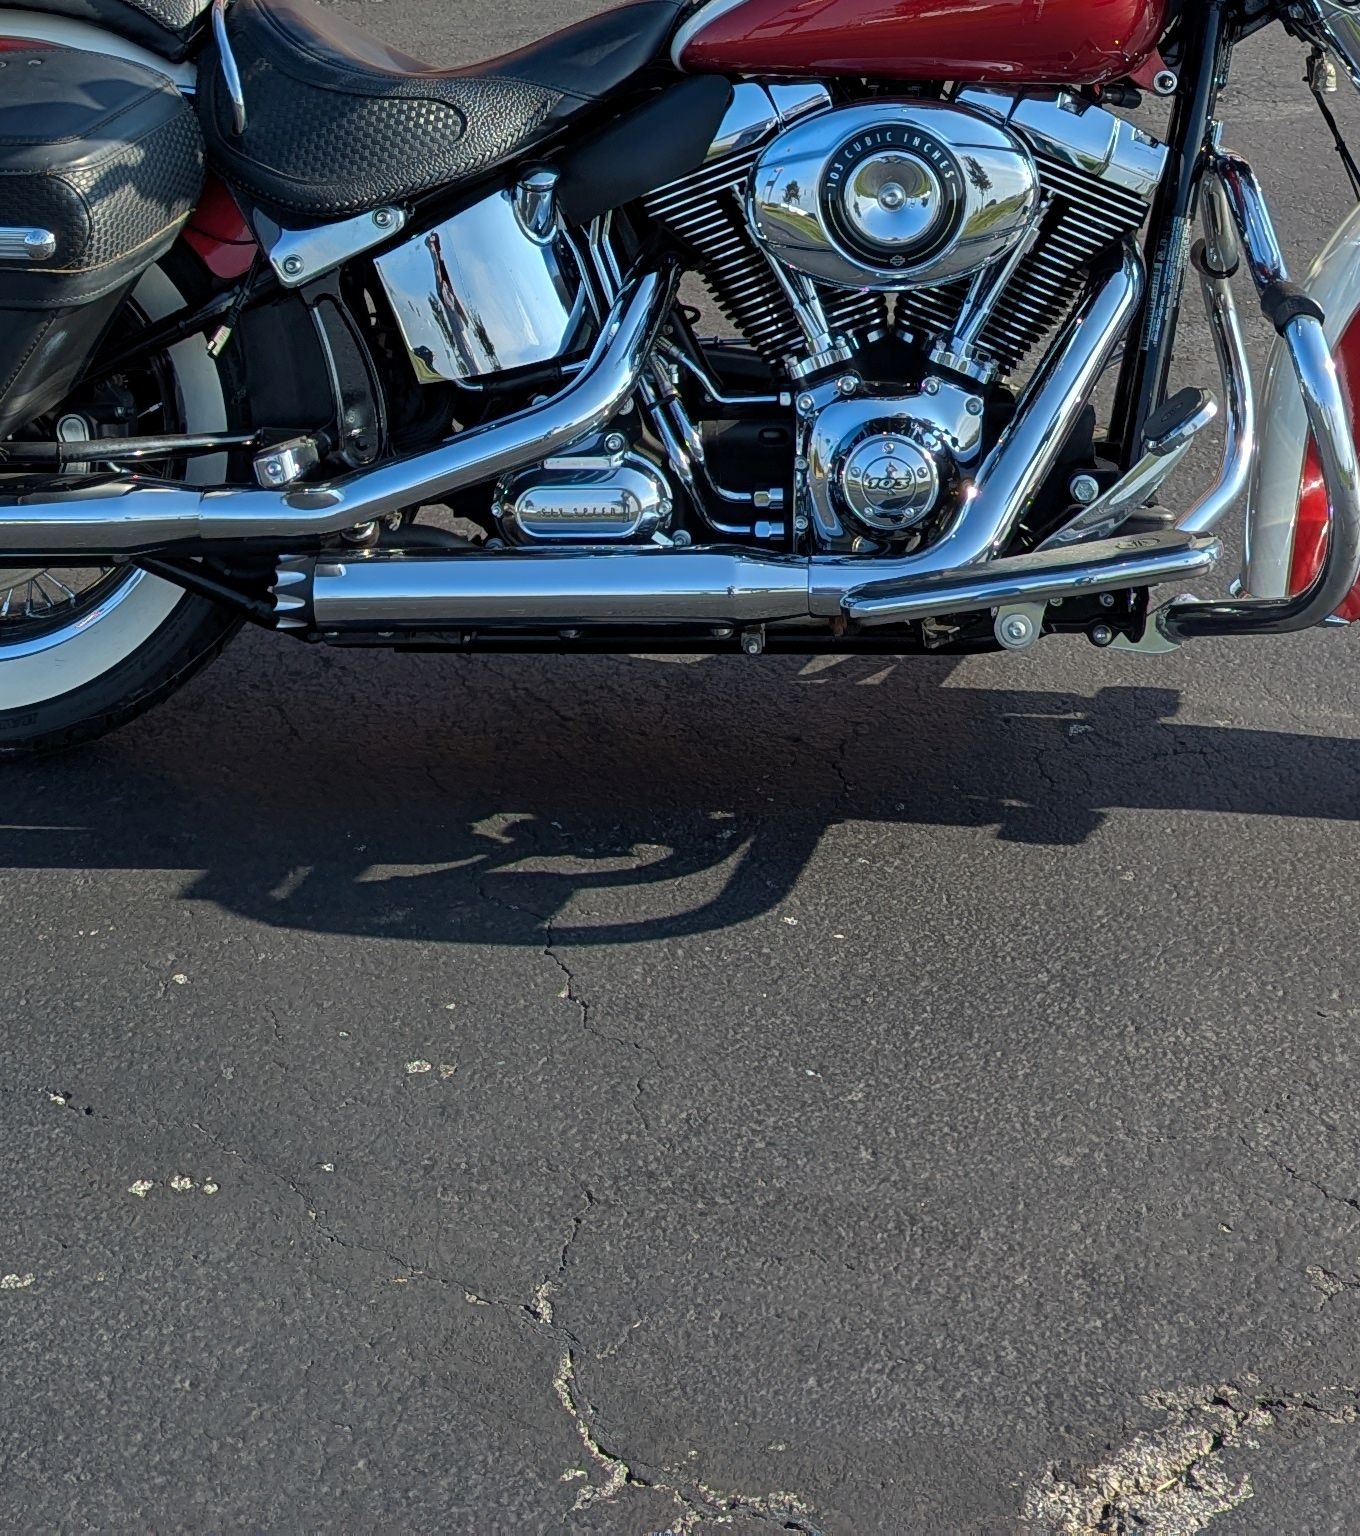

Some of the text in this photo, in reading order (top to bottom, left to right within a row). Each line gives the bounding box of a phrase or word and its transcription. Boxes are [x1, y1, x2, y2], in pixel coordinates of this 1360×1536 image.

[826, 131, 955, 188] 103 CUBIC INCHES
[867, 477, 912, 490] 103
[573, 507, 616, 517] SPEED
